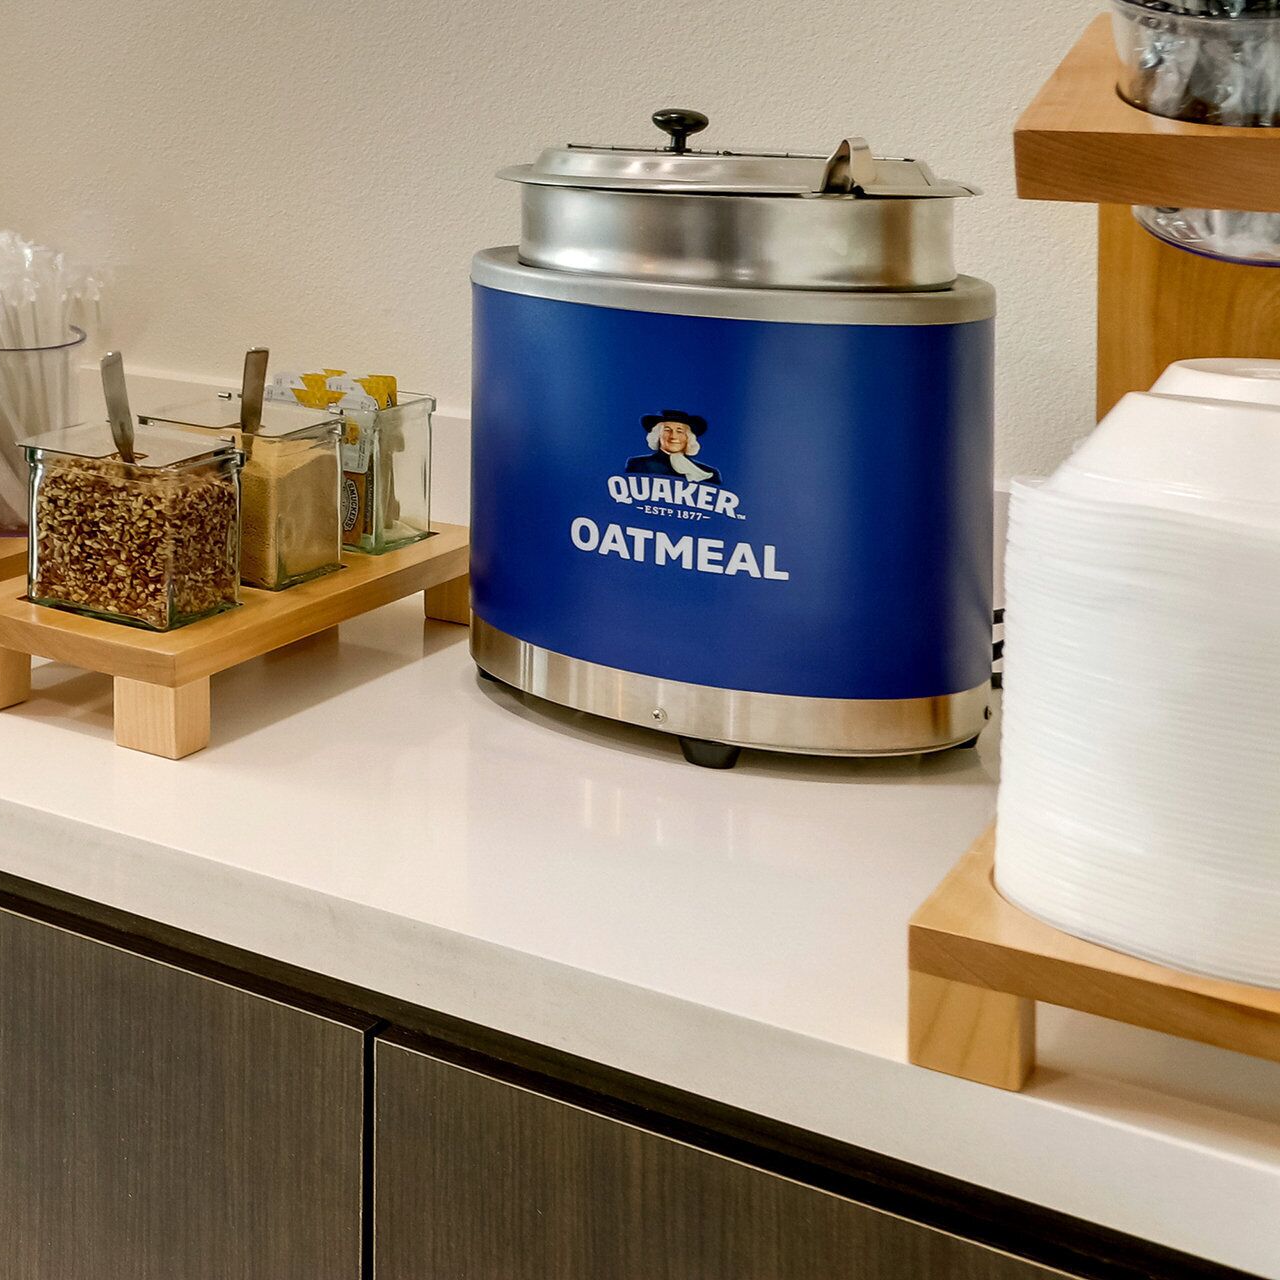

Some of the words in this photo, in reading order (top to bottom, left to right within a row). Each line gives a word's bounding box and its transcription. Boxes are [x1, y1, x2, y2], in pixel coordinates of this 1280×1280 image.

[607, 475, 740, 520] QUAKER
[677, 509, 703, 521] 1877
[570, 517, 790, 581] OATMEAL
